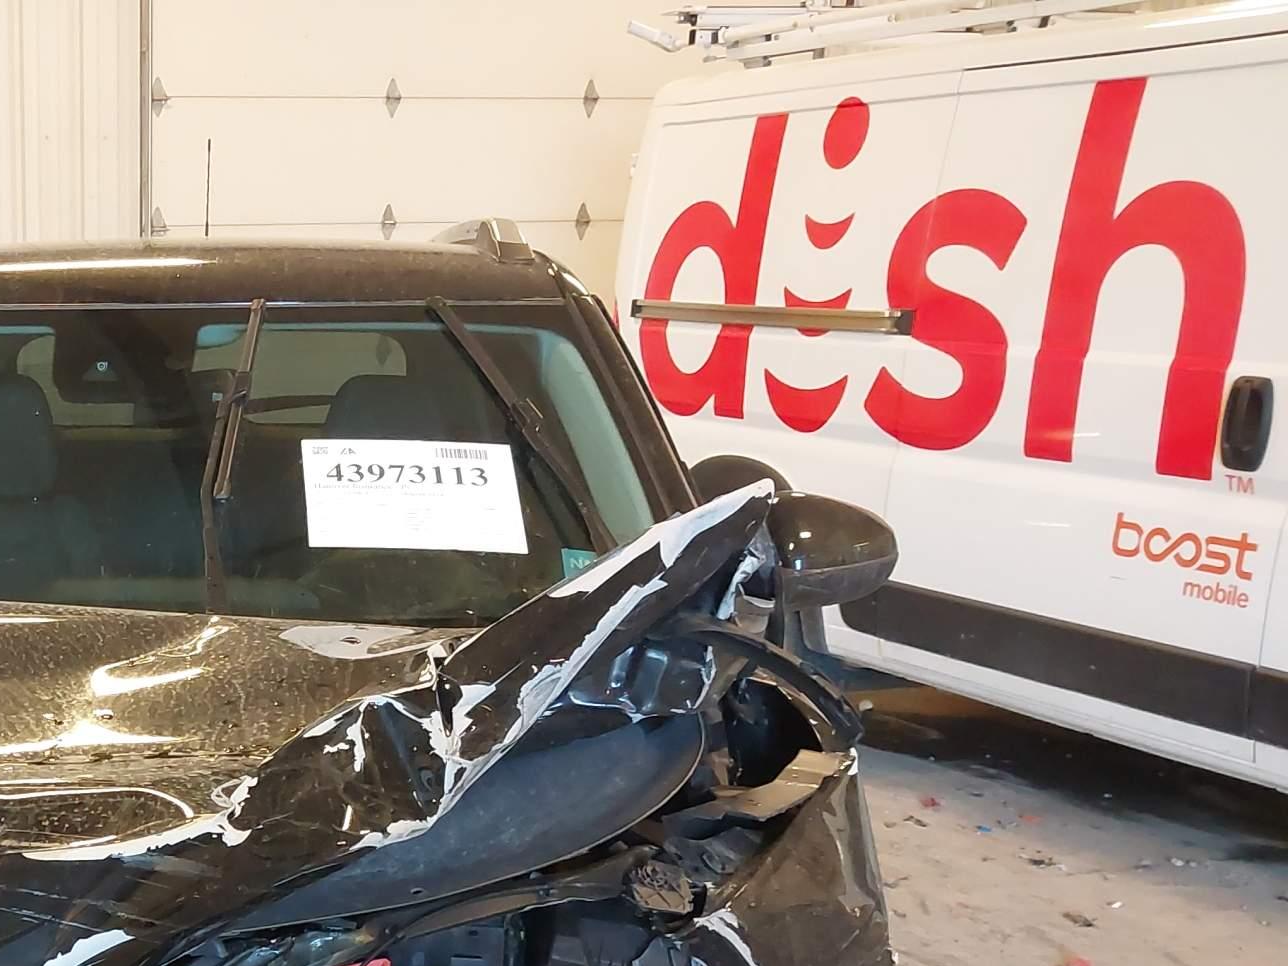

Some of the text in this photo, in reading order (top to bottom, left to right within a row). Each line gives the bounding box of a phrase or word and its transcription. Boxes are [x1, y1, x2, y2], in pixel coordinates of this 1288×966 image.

[640, 77, 1246, 481] dish
[326, 463, 489, 487] 43973113
[1225, 474, 1255, 495] TM
[1112, 511, 1258, 581] boost
[1182, 581, 1249, 609] mobile
